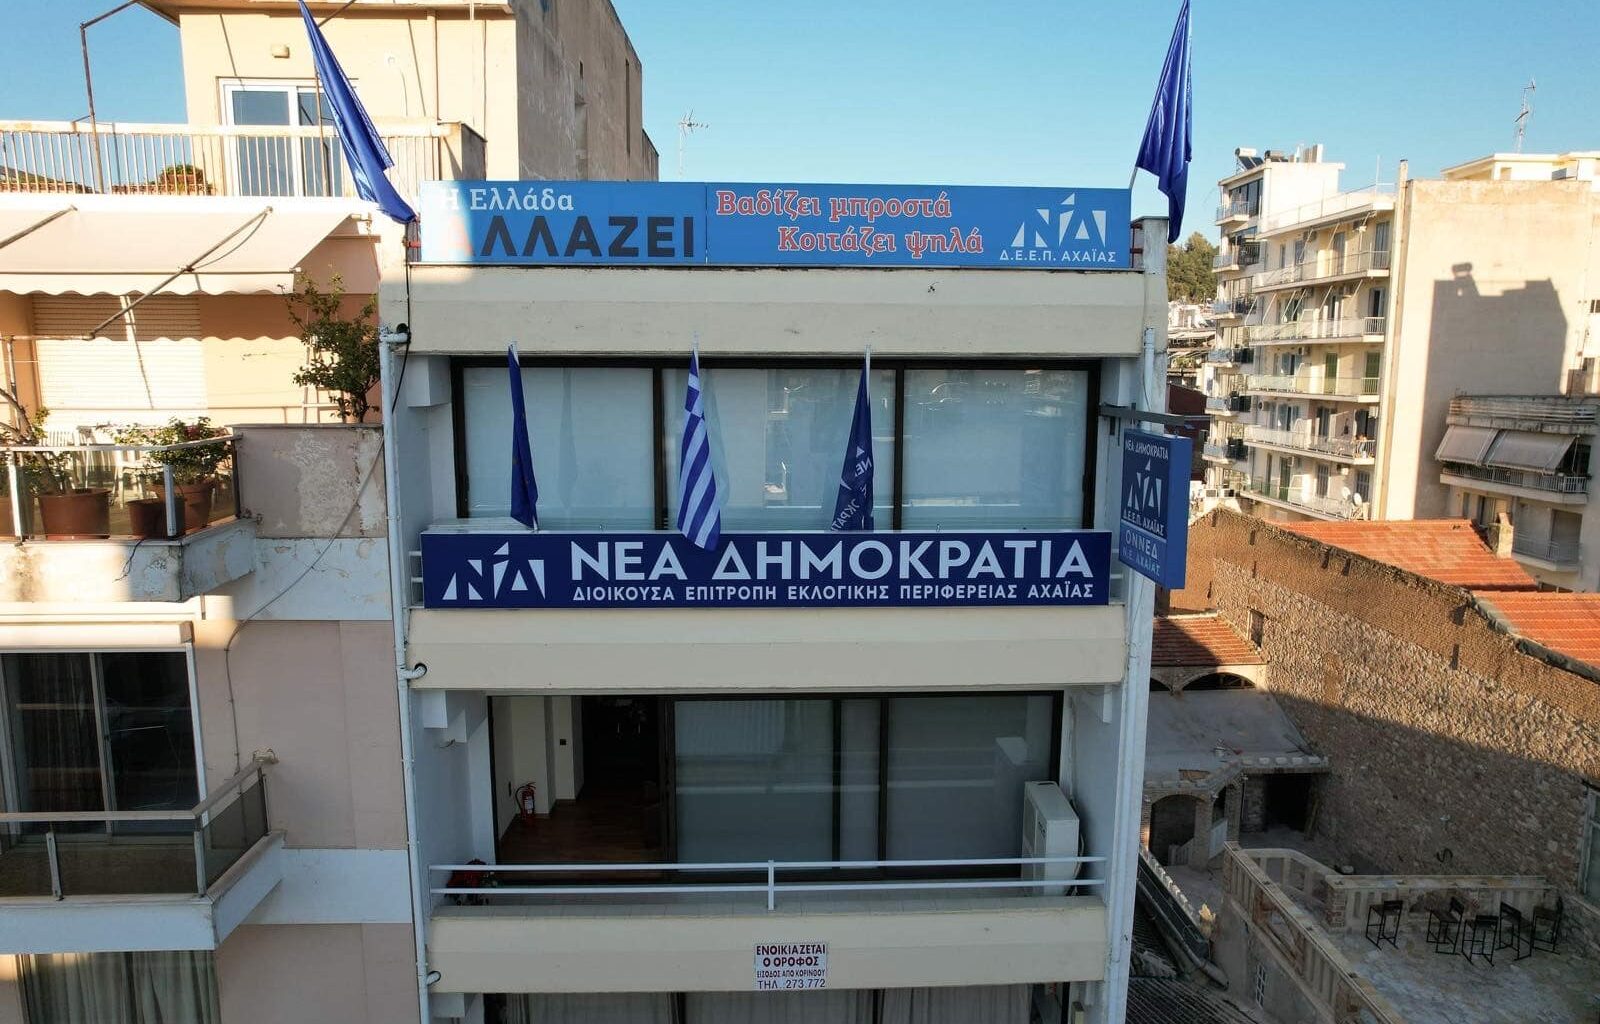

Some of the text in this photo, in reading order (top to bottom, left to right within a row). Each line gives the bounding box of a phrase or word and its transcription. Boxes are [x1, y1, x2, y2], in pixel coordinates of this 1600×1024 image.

[470, 187, 574, 211] Ελλάδα
[716, 189, 952, 222] Βαδίζει μπροστά
[778, 226, 984, 259] Κοιτάζει ψηλά
[1000, 248, 1117, 262] Δ.Ε.Ε.Π. ΑΧΑΪΑΣ
[1126, 530, 1158, 559] ΟΝΝΕΔ
[571, 539, 1094, 581] ΝΕΑ ΔΗΜΟΚΡΑΤΙΑ
[573, 580, 1094, 601] ΔΙΟΙΚΟΥΣΑ ΕΠΙΤΡΟΠΗ ΕΚΛΟΓΙΚΗΣ ΠΕΡΙΦΕΡΕΙΑΣ ΑΧΑΪΑΣ
[756, 944, 826, 956] ΕΝΟΙΚΙΑΖΕΤΑΙ
[763, 956, 819, 968] Ο ΟΡΟΦΟΣ
